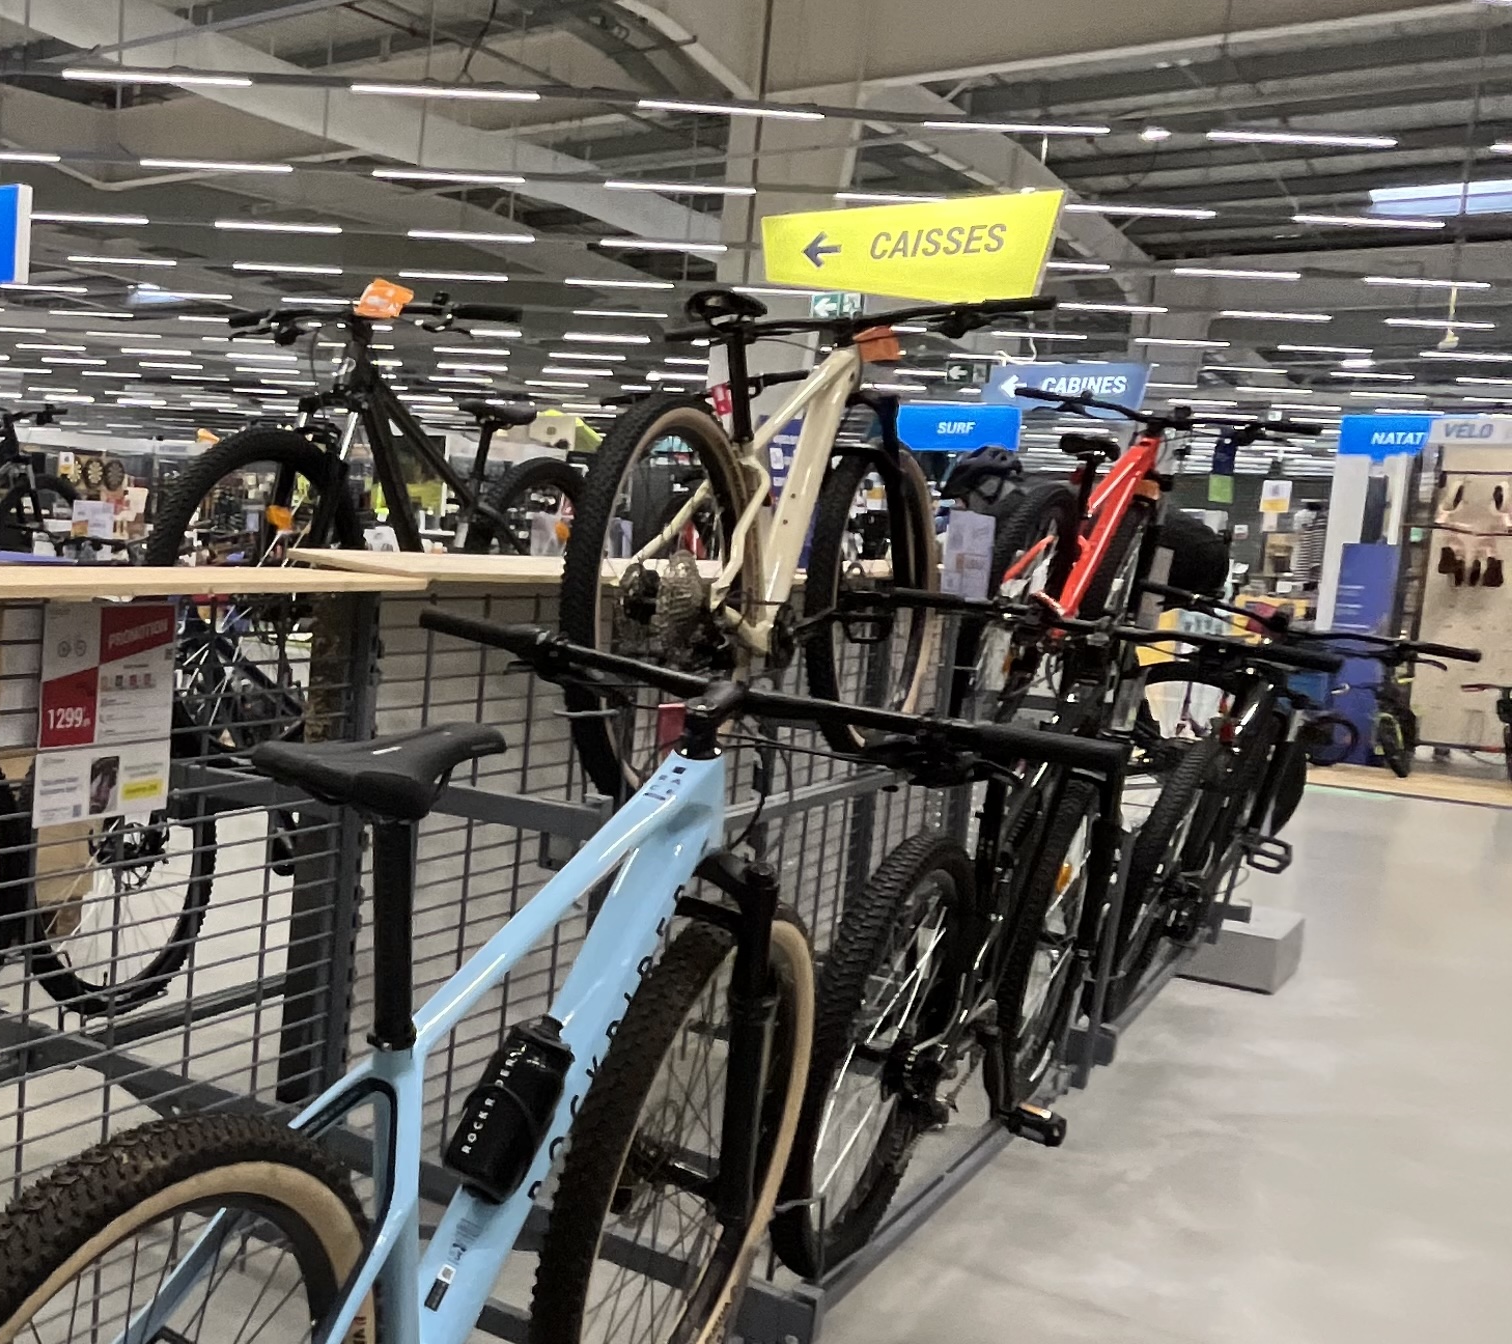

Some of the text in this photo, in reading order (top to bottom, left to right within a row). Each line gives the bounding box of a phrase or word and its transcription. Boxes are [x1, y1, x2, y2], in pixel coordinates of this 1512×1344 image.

[869, 223, 1007, 261] CAISSES
[1041, 375, 1128, 395] CABINES
[937, 421, 976, 435] SURF
[461, 1058, 518, 1154] ROCKRDER
